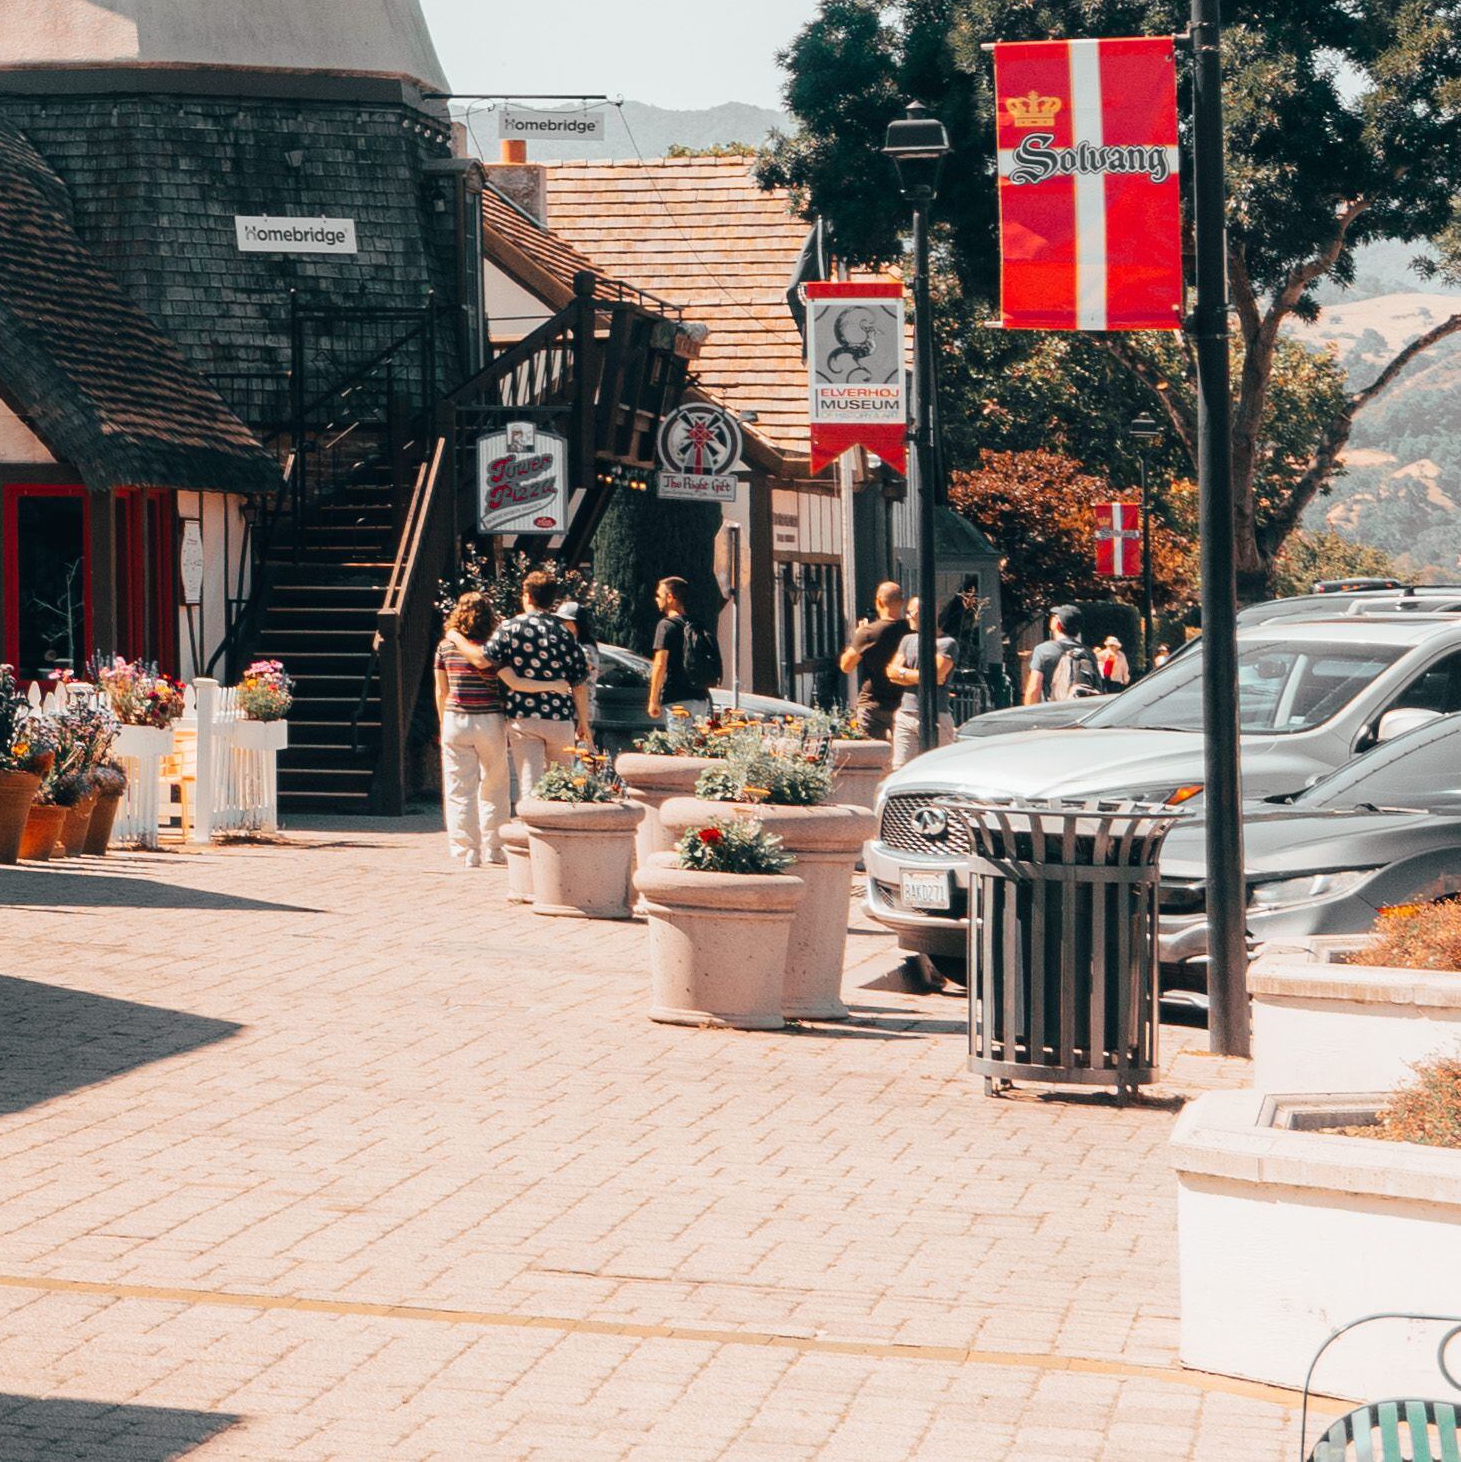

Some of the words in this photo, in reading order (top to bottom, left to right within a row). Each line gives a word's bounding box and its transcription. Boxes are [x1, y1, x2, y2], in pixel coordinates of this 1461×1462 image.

[505, 118, 596, 134] Homebridge
[1009, 132, 1171, 186] Solvang
[245, 225, 346, 246] Homebridge
[820, 399, 900, 410] MUSEUM
[487, 453, 554, 486] Tower
[662, 475, 683, 489] The
[683, 476, 709, 493] Right
[711, 478, 731, 493] Gift
[485, 477, 559, 514] Pizza
